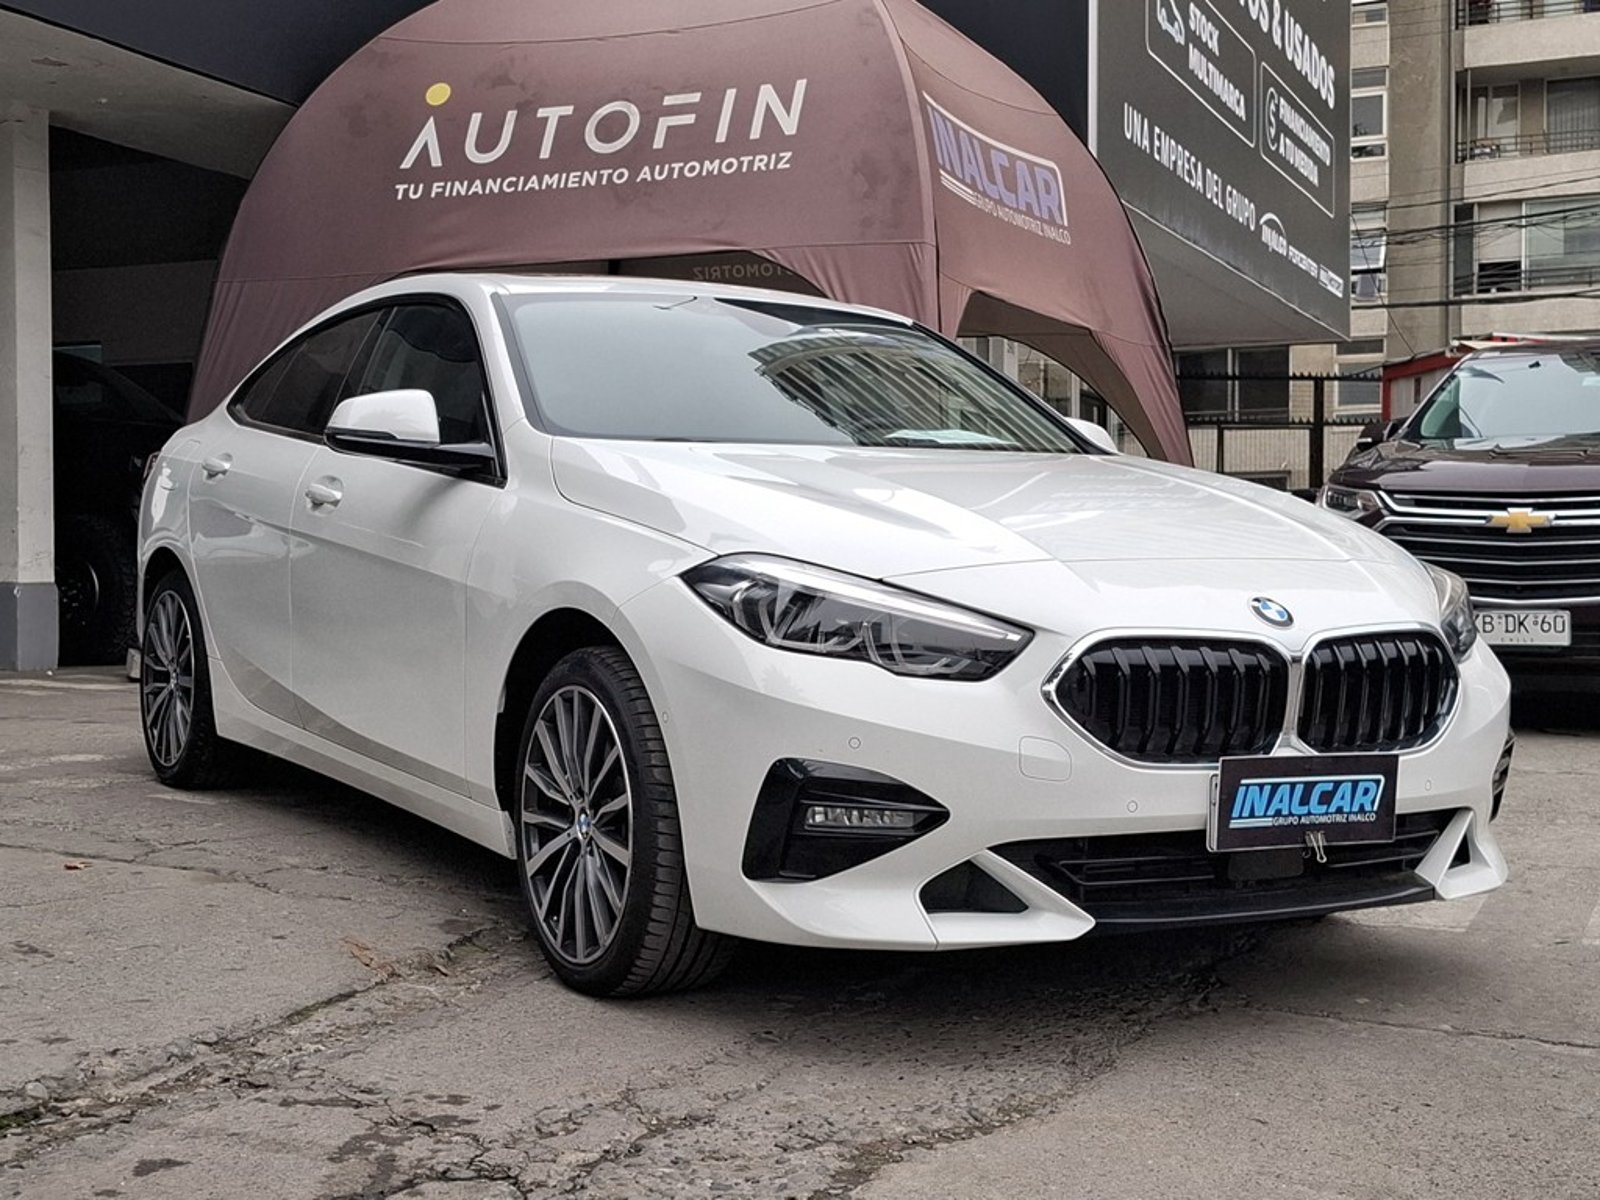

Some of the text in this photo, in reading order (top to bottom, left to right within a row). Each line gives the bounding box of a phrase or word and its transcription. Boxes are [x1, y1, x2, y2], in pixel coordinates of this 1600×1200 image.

[1188, 1, 1220, 57] STOCK
[1284, 8, 1335, 110] USADOS
[1188, 42, 1246, 121] MULTIMARCA
[399, 78, 808, 169] AUTOFIN
[395, 151, 793, 200] TU FINANCIAMIENTO AUTOMOTRIZ
[926, 104, 1064, 226] INALCAR
[1124, 101, 1256, 231] UNA EMPRESA DEL GRUPO
[1231, 780, 1378, 818] INALCAR
[1273, 812, 1376, 826] GRUPO AUTOMOTRIZ INALCO
